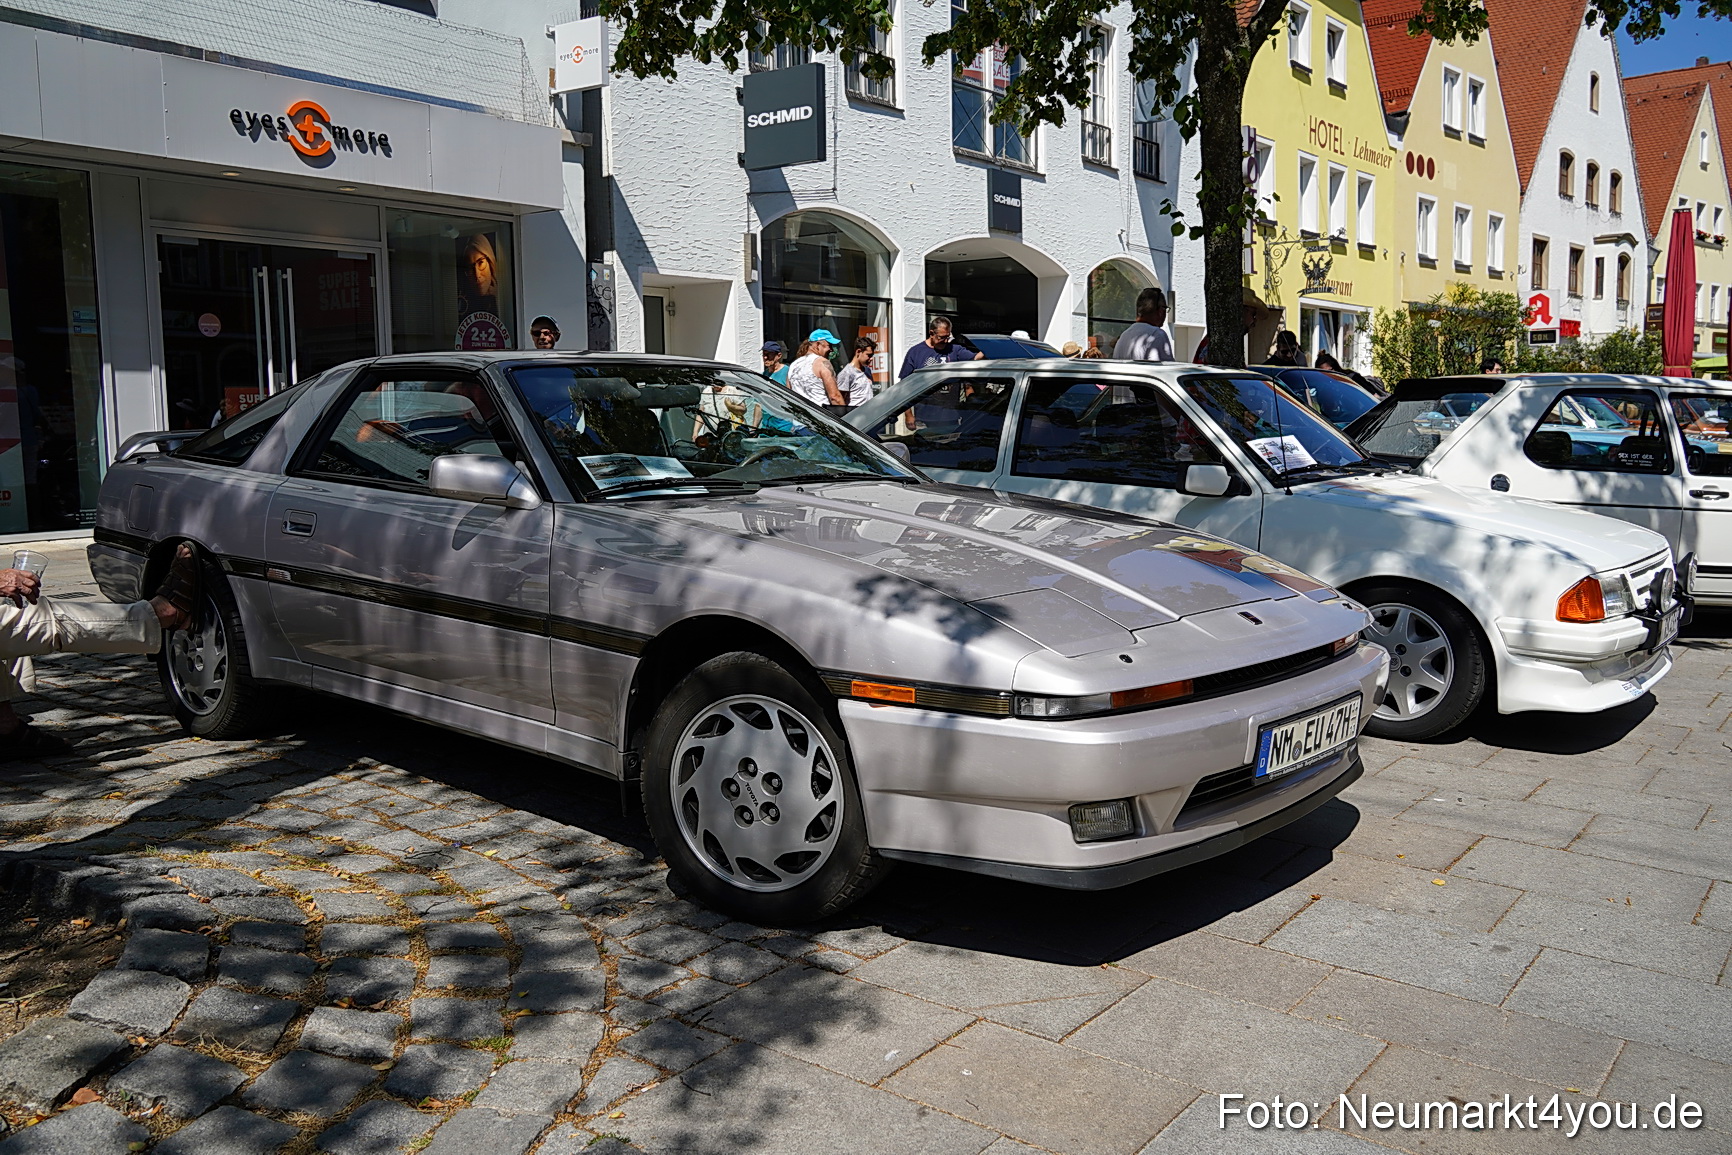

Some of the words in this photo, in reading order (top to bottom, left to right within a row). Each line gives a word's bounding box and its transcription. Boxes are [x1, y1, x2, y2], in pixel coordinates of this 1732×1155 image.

[559, 52, 573, 61] eyes
[583, 47, 599, 56] more
[229, 108, 287, 131] eyes
[331, 124, 389, 147] more
[747, 105, 813, 128] SCHMID
[1309, 115, 1345, 156] HOTEL
[1353, 136, 1393, 169] Lehmeier
[993, 193, 1021, 208] SCHMID
[318, 270, 359, 290] SUPER
[320, 288, 360, 311] SALE
[457, 315, 473, 338] JETZT
[474, 312, 510, 340] KOSTENLOS
[471, 327, 496, 341] 2+2
[1269, 726, 1295, 769] NM
[1325, 704, 1352, 745] 47H
[1259, 757, 1266, 769] D
[744, 782, 759, 807] TOYOTA
